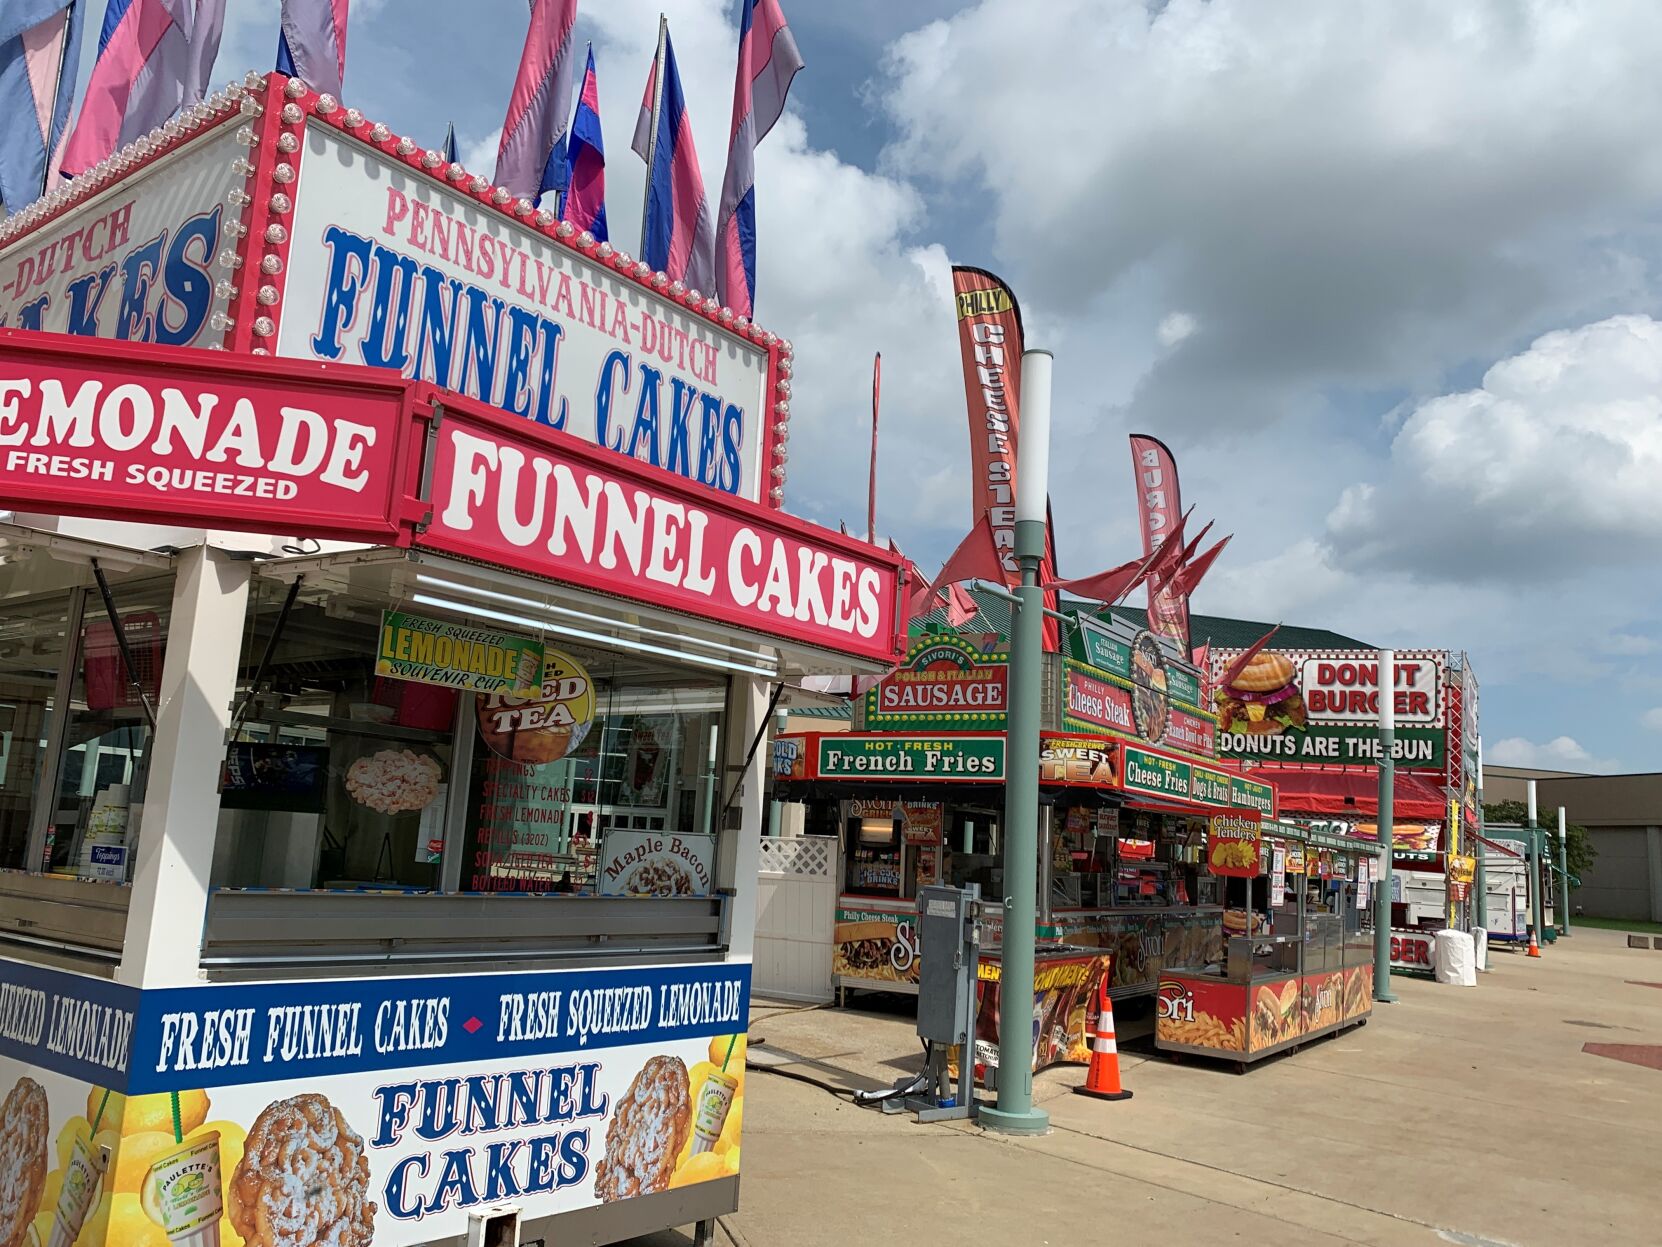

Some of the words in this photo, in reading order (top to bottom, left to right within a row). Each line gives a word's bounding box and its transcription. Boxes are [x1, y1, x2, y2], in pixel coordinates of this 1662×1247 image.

[0, 202, 224, 347] KES
[382, 186, 720, 386] PENNSYLVANIA-DUTCH
[958, 289, 1002, 314] PHILLY
[310, 224, 569, 433] FUNNEL
[596, 348, 744, 495] CAKES
[972, 322, 1010, 455] CHEESE
[6, 450, 114, 482] FRESH
[126, 463, 298, 500] SQUEEZED
[988, 460, 1020, 573] STEAK
[442, 430, 717, 597] FUNNEL
[727, 528, 882, 639] CAKES
[402, 616, 442, 633] FRESH
[445, 626, 505, 646] SQUEEZED
[382, 625, 518, 680] LEMONADE
[922, 650, 965, 665] SIVORI'S
[1095, 642, 1124, 665] Sausage
[390, 661, 470, 686] SOUVENIR
[474, 677, 506, 692] CUP
[1084, 681, 1105, 695] PHILLY
[884, 683, 1002, 706] SAUSAGE
[1069, 683, 1103, 718] Cheese
[1105, 696, 1131, 727] Steak
[493, 703, 577, 733] TEA
[826, 750, 914, 772] French
[924, 751, 995, 772] Fries
[865, 742, 894, 751] HOT
[904, 742, 954, 751] FRESH
[1041, 748, 1109, 763] SWEET
[1221, 733, 1296, 754] DONUTS
[1302, 736, 1339, 757] ARE
[1346, 738, 1384, 759] THE
[1391, 739, 1433, 760] BUN
[1040, 760, 1114, 785] TEA
[1127, 761, 1162, 788] Cheese
[1165, 770, 1188, 793] Fries
[541, 785, 571, 803] CAKES
[1232, 785, 1271, 810] Hamburgers
[514, 807, 565, 825] LEMONADE
[1213, 814, 1257, 831] Chicken
[1215, 826, 1257, 842] Tenders
[604, 837, 664, 882] Maple
[668, 836, 711, 889] Bacon
[1393, 852, 1430, 861] UTS
[843, 910, 861, 920] Philly
[861, 912, 881, 922] Cheese
[881, 914, 899, 923] Steak
[1034, 964, 1090, 992] ONDIMENTS
[496, 990, 562, 1043] FRESH
[566, 985, 652, 1046] SQUEEZED
[658, 979, 742, 1028] LEMONADE
[46, 994, 134, 1075] LEMONADE
[156, 1007, 256, 1074] FRESH
[263, 1001, 363, 1064] FUNNEL
[374, 997, 451, 1055] CAKES
[369, 1061, 609, 1149] FUNNEL
[162, 1163, 213, 1191] PAULETTE'S
[382, 1127, 590, 1221] CAKES
